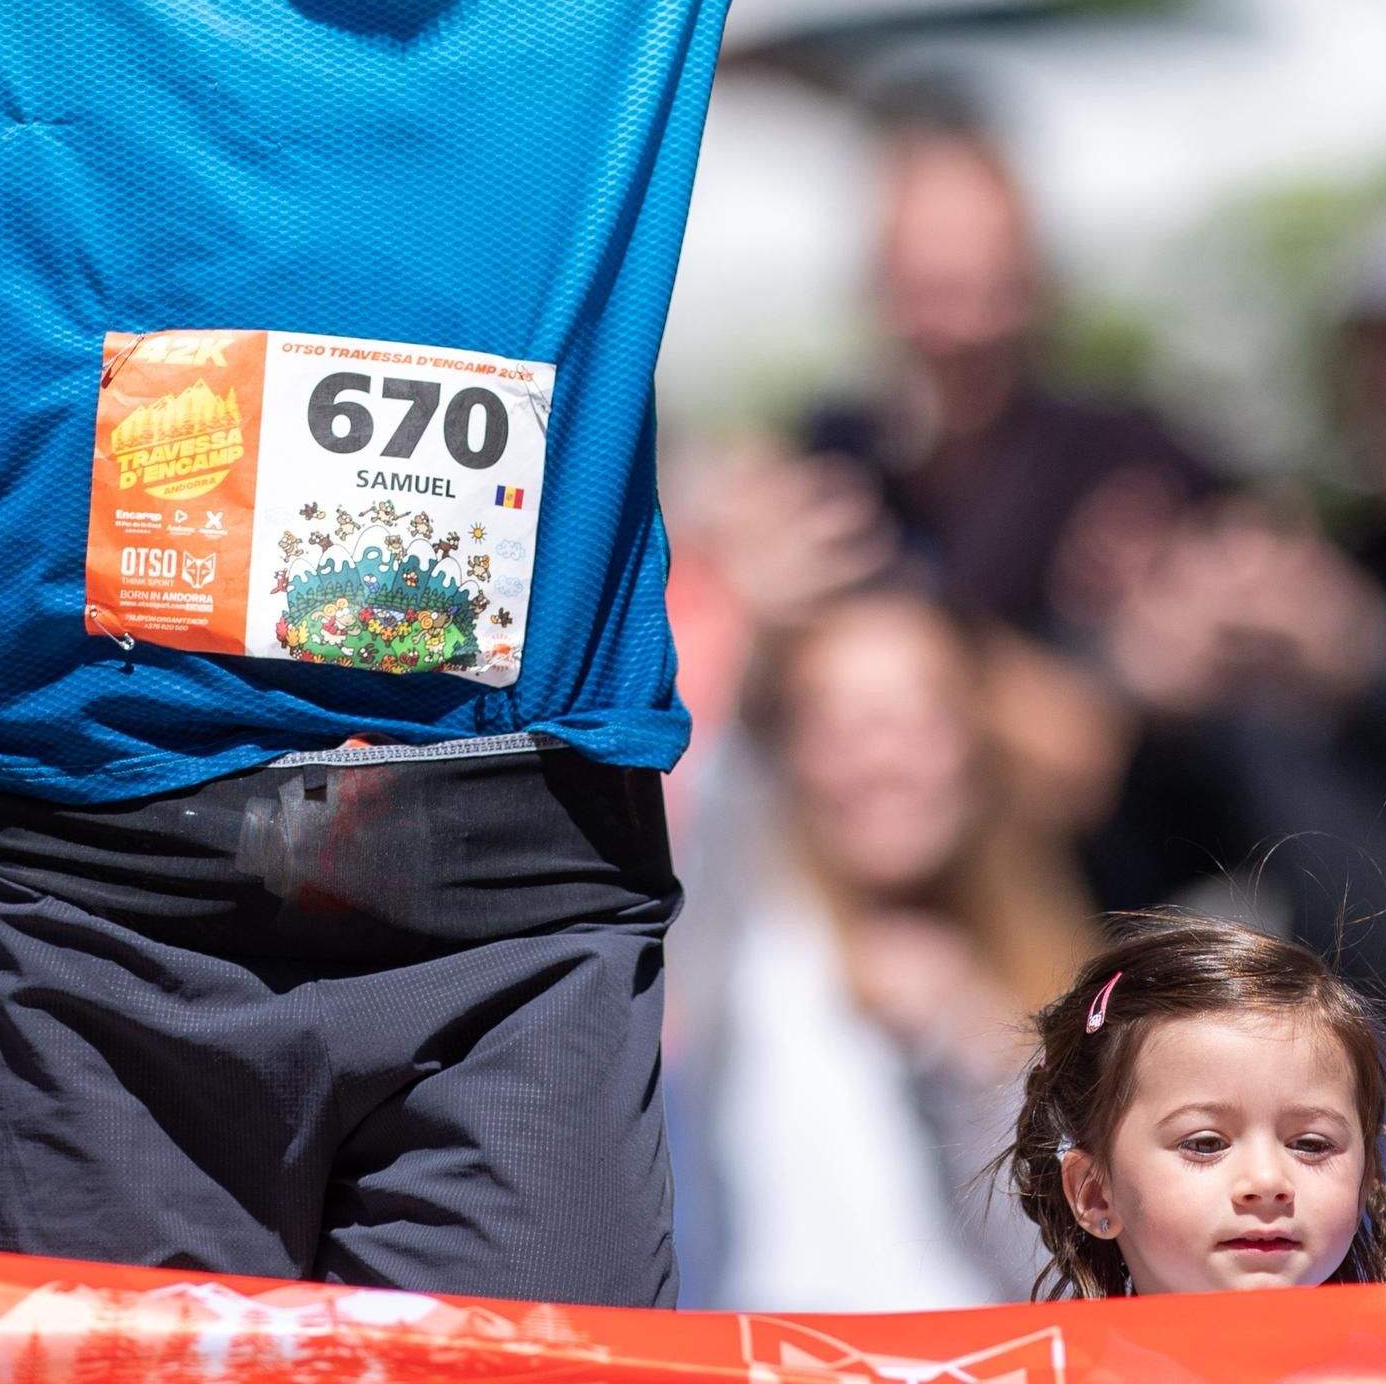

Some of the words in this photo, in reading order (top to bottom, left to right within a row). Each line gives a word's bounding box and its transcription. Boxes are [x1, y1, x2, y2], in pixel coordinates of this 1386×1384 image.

[282, 343, 325, 356] OTSO
[330, 347, 413, 364] TRAVESSA
[416, 356, 497, 375] D'ENCAMP
[308, 371, 509, 470] 670
[116, 427, 243, 473] TRAVESSA
[119, 445, 244, 490] D'ENCAMP
[164, 477, 217, 495] ANDORRA
[356, 469, 456, 498] SAMUEL
[121, 547, 177, 578] OTSO
[120, 589, 148, 599] BORN
[150, 591, 160, 600] IN
[162, 591, 213, 603] ANDORRA
